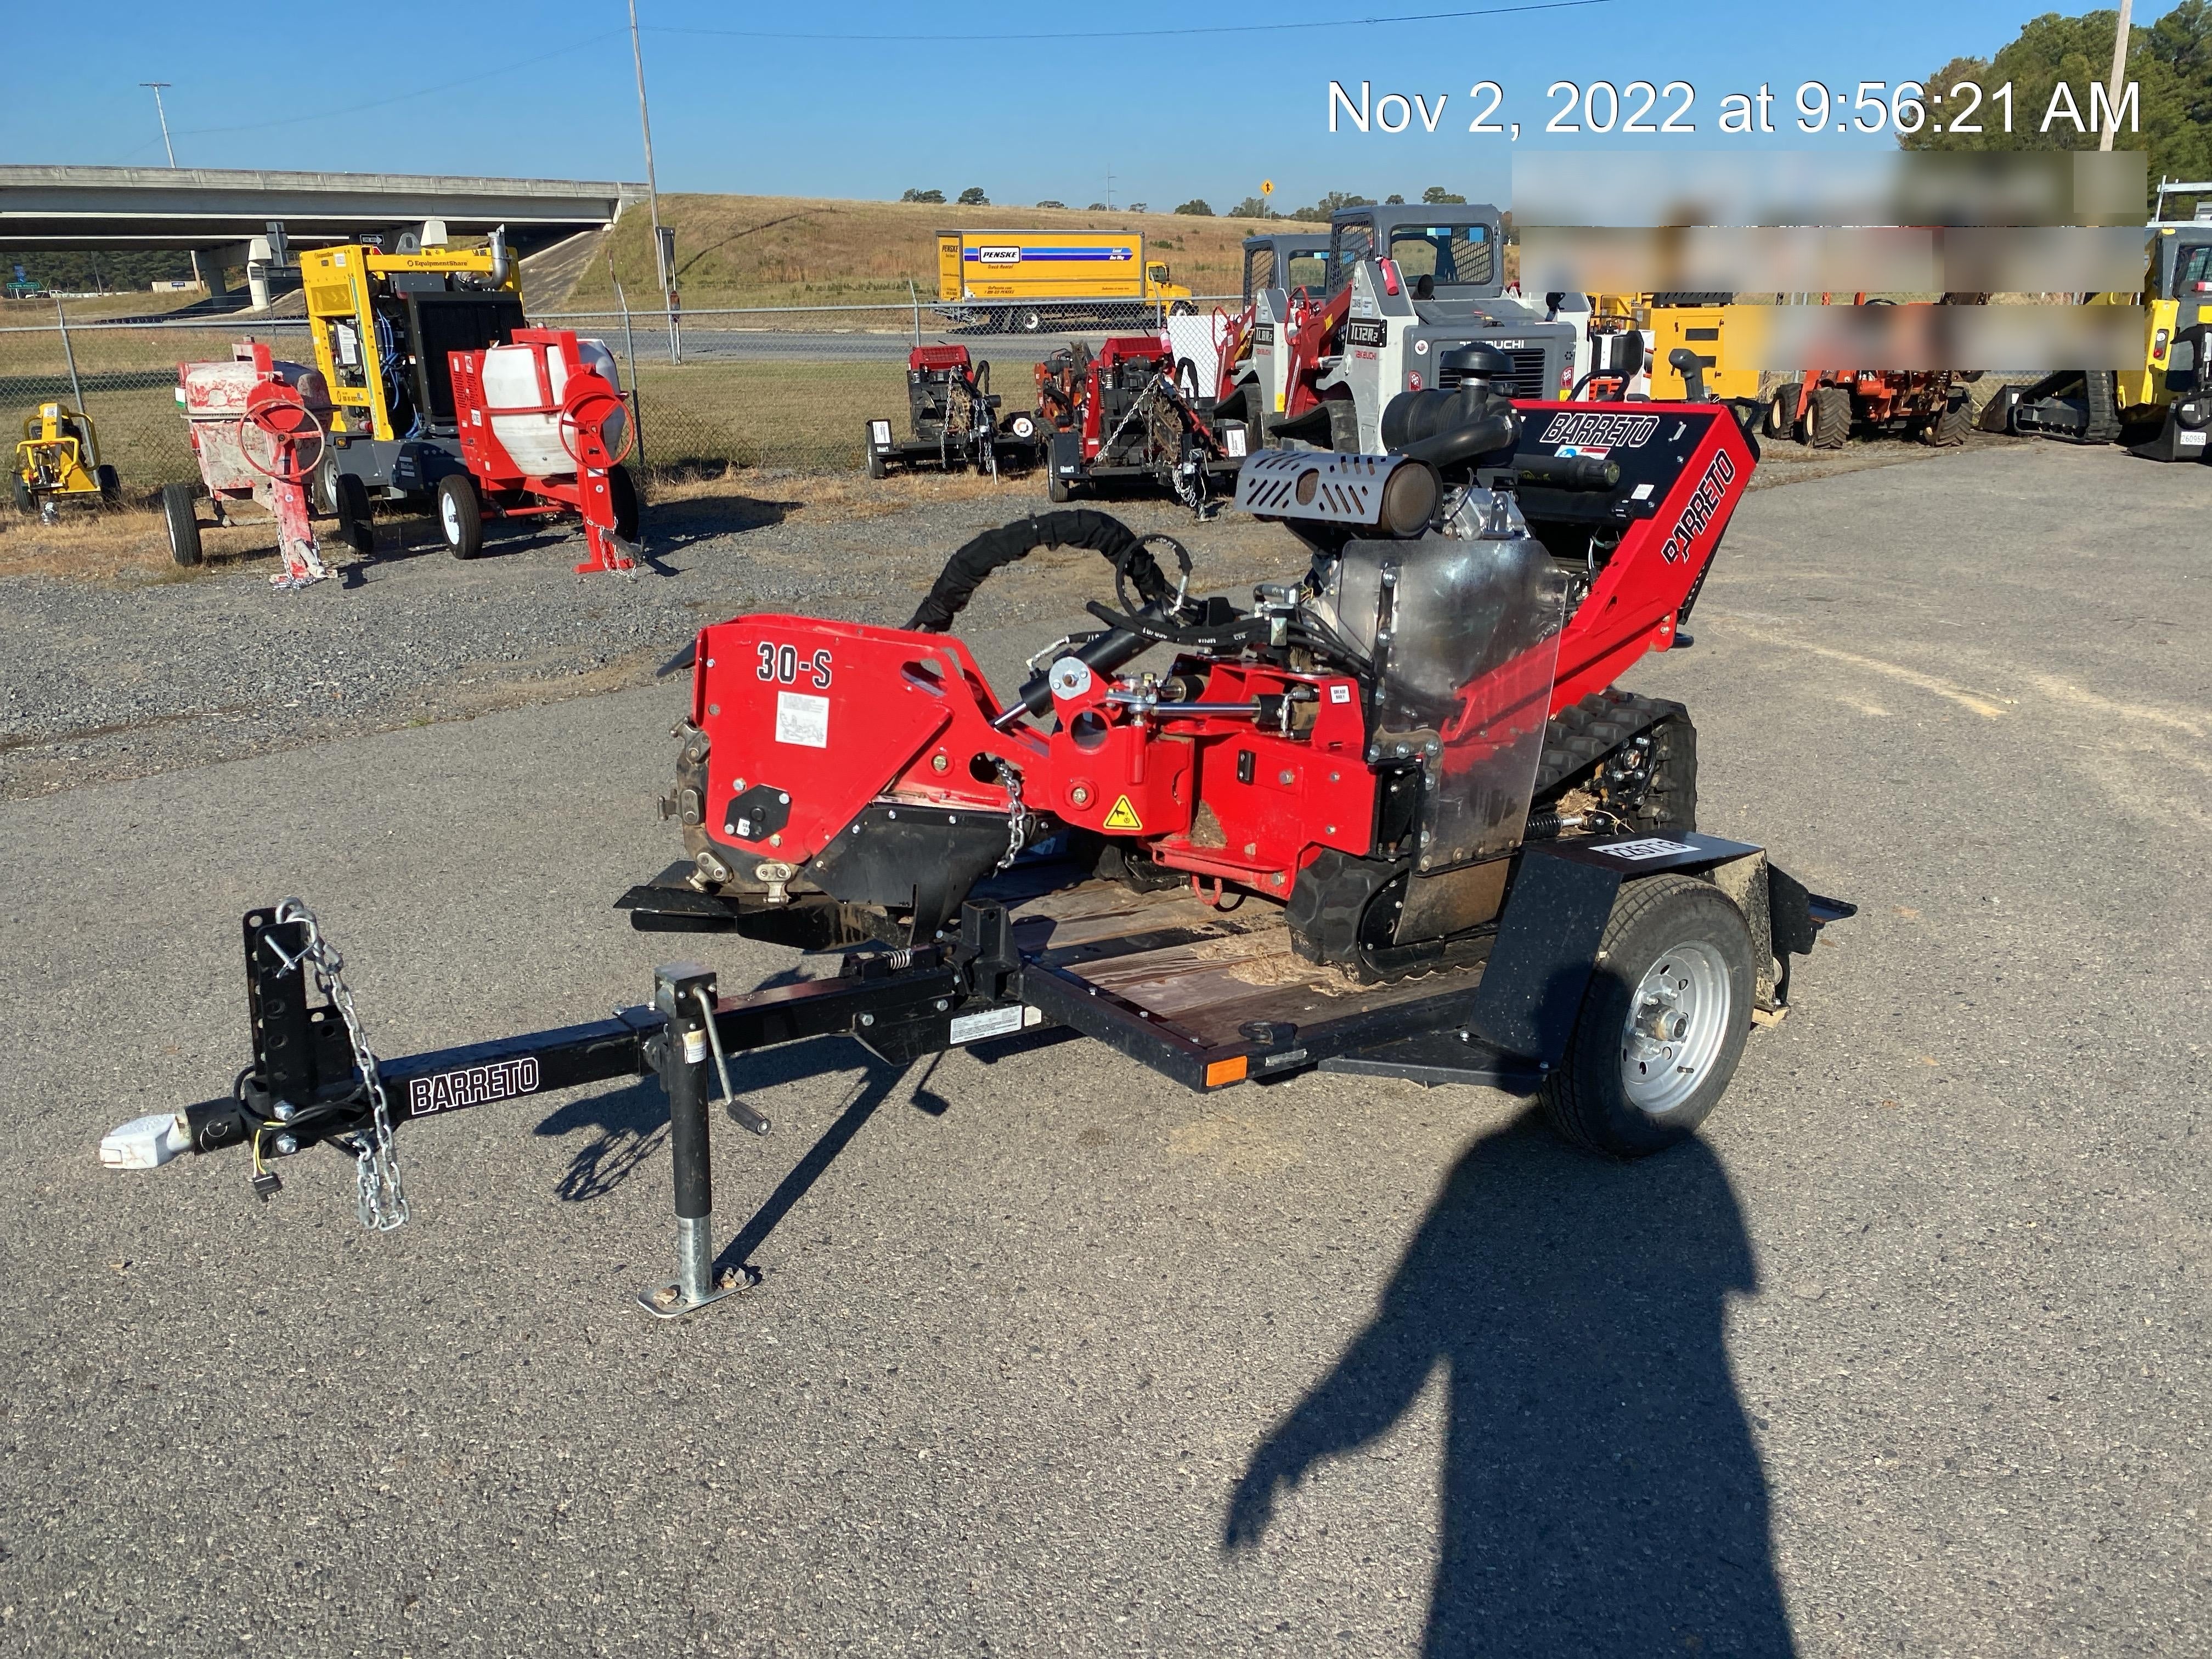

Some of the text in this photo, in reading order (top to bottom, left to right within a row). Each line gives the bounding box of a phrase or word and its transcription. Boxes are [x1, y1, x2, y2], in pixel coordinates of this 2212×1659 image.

[942, 245, 958, 253] PENSKE
[1351, 323, 1380, 342] TL12R2
[1539, 412, 1660, 447] BARRETO
[757, 640, 833, 690] 30-S
[1602, 840, 1688, 857] 226713
[410, 1057, 539, 1115] BARRETO
